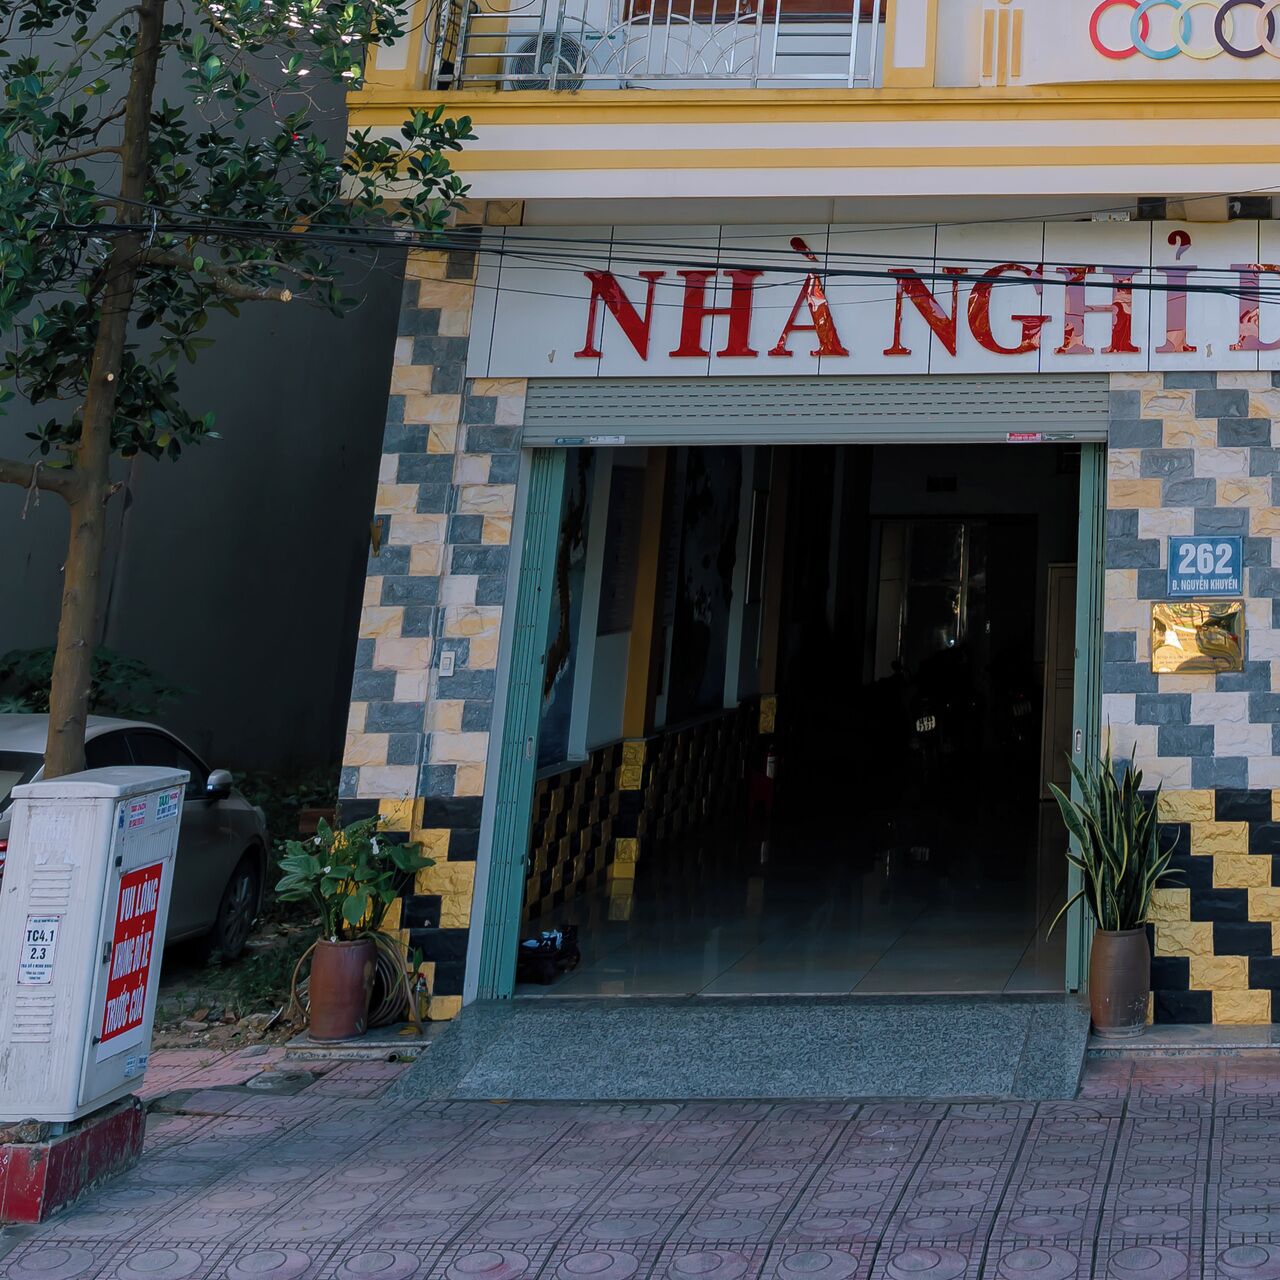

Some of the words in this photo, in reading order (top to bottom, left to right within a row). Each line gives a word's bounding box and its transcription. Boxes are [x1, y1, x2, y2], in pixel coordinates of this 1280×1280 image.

[575, 236, 850, 361] NHÀ
[884, 228, 1193, 355] NGHỈ
[1179, 543, 1233, 574] 262
[120, 888, 133, 922] VUI
[136, 874, 158, 915] LÒNG
[27, 930, 54, 942] TC4.1
[30, 948, 46, 959] 2.3
[112, 932, 135, 980] KHÔNG
[141, 930, 151, 968] XE
[104, 984, 130, 1035] TRƯỚC
[129, 973, 145, 1024] CỬA
